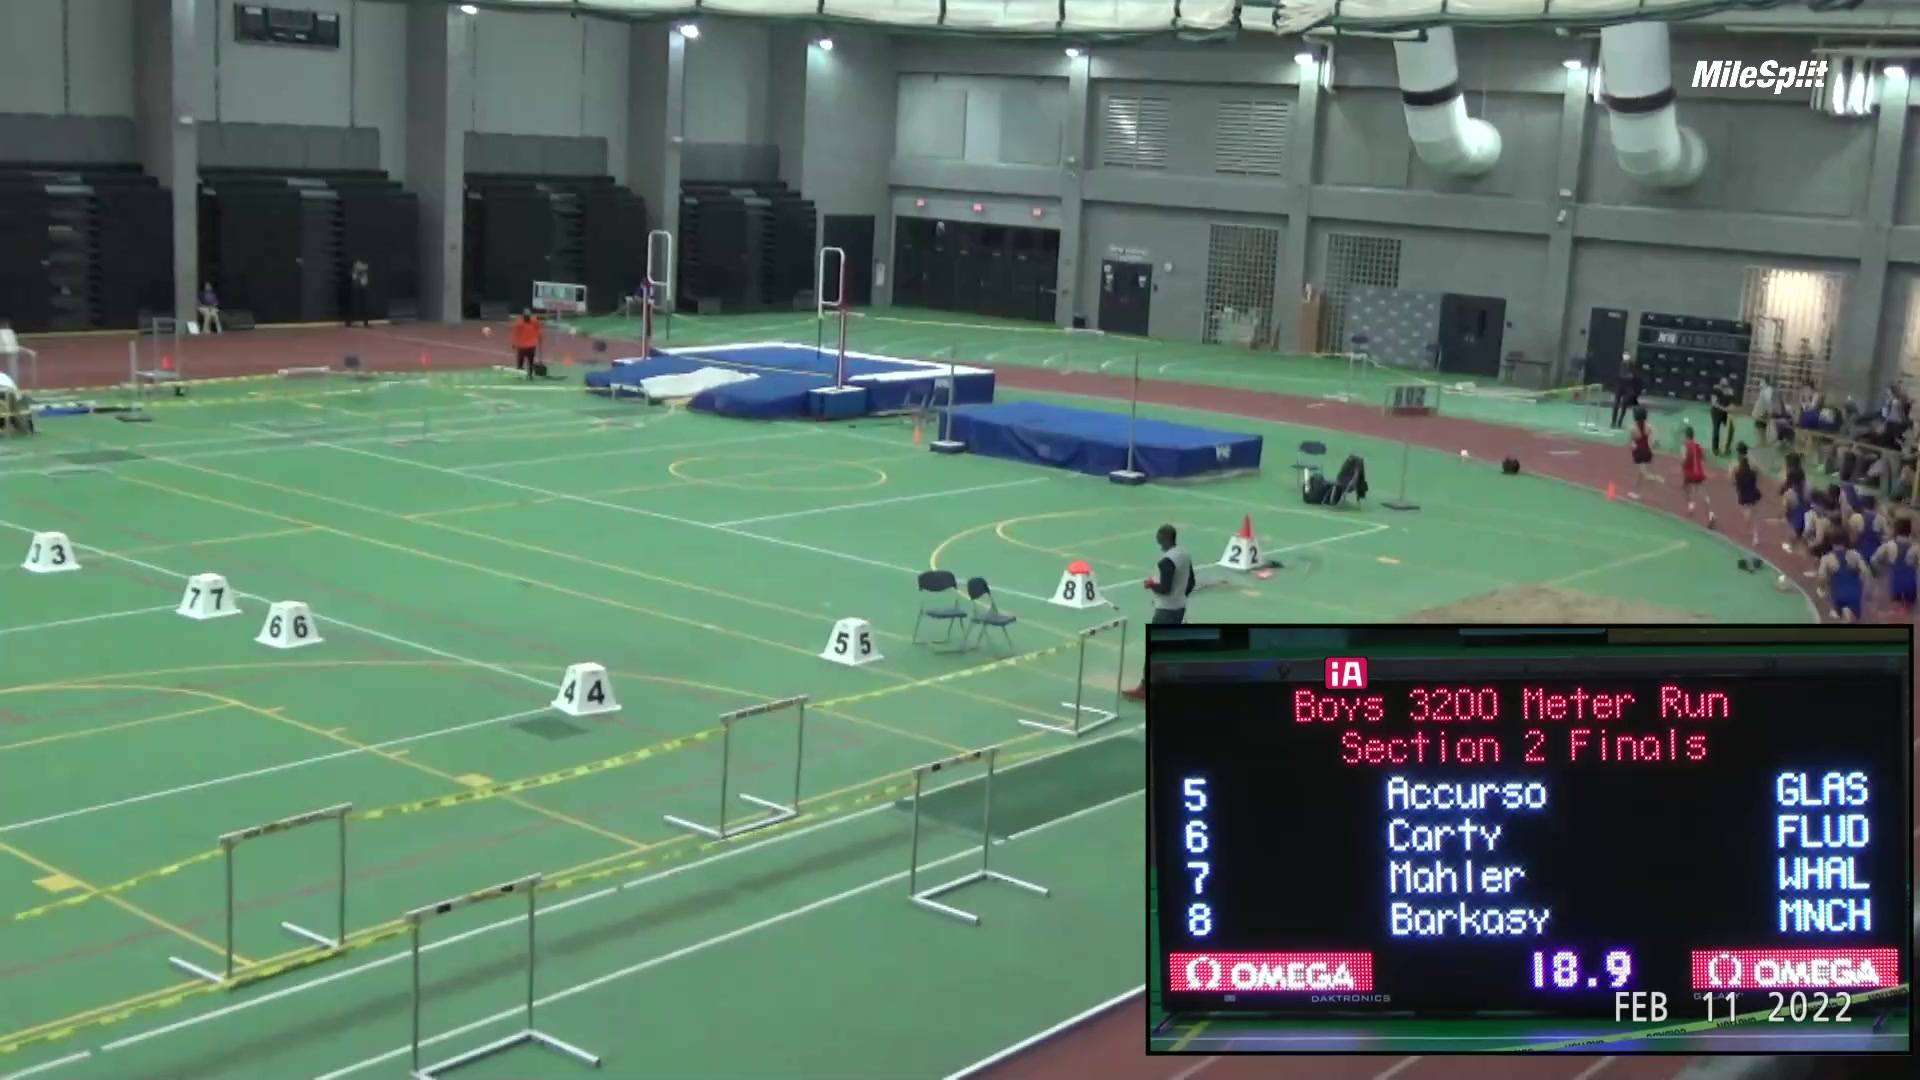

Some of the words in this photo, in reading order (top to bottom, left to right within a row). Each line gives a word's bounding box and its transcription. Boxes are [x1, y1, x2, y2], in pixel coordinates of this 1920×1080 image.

[51, 544, 66, 565] 3
[1249, 545, 1258, 564] 2
[210, 588, 224, 610] 7
[1085, 581, 1095, 601] 8
[293, 615, 308, 638] 6
[860, 632, 871, 655] 5
[587, 679, 605, 705] 4
[1294, 689, 1385, 723] Boys
[1408, 686, 1498, 720] 3200
[1523, 686, 1636, 719] Meter
[1661, 685, 1729, 718] Run
[1341, 731, 1500, 763] Section
[1525, 730, 1545, 762] 2
[1570, 728, 1707, 761] Finals
[1184, 778, 1207, 812] 5
[1387, 775, 1547, 810] Accurso
[1776, 772, 1869, 806] GLAS
[1185, 820, 1209, 853] 6
[1388, 818, 1501, 852] Carty
[1777, 814, 1869, 848] FLUD
[1186, 861, 1210, 895] 7
[1390, 860, 1526, 893] Mahler
[1778, 856, 1871, 890] WHAL
[1188, 903, 1212, 936] 8
[1391, 901, 1551, 935] Barkasy
[1779, 898, 1871, 932] MNCH
[1230, 961, 1355, 988] OMEGA
[1533, 951, 1631, 988] 18.9
[1753, 958, 1881, 986] OMEGA
[1311, 994, 1391, 1003] DAKTRONICS
